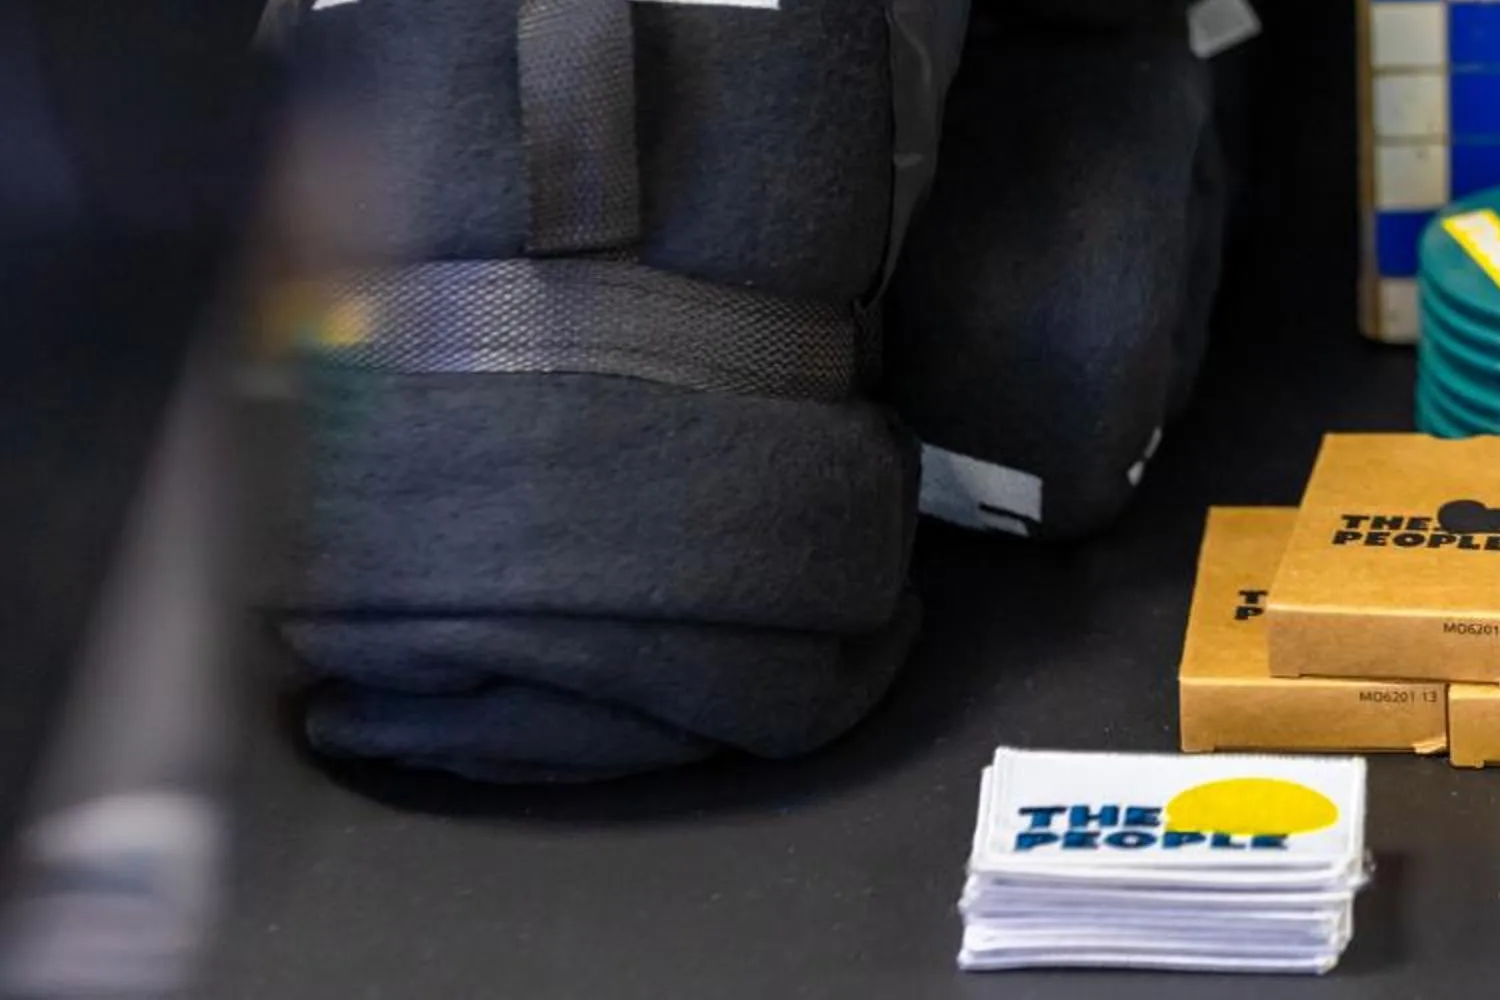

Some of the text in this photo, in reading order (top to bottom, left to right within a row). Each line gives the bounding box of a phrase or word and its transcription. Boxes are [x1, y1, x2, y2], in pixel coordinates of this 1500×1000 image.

[1340, 514, 1432, 531] THE
[1359, 690, 1438, 703] MO620113
[1018, 804, 1166, 830] THE
[1013, 830, 1290, 852] PEOPLE
